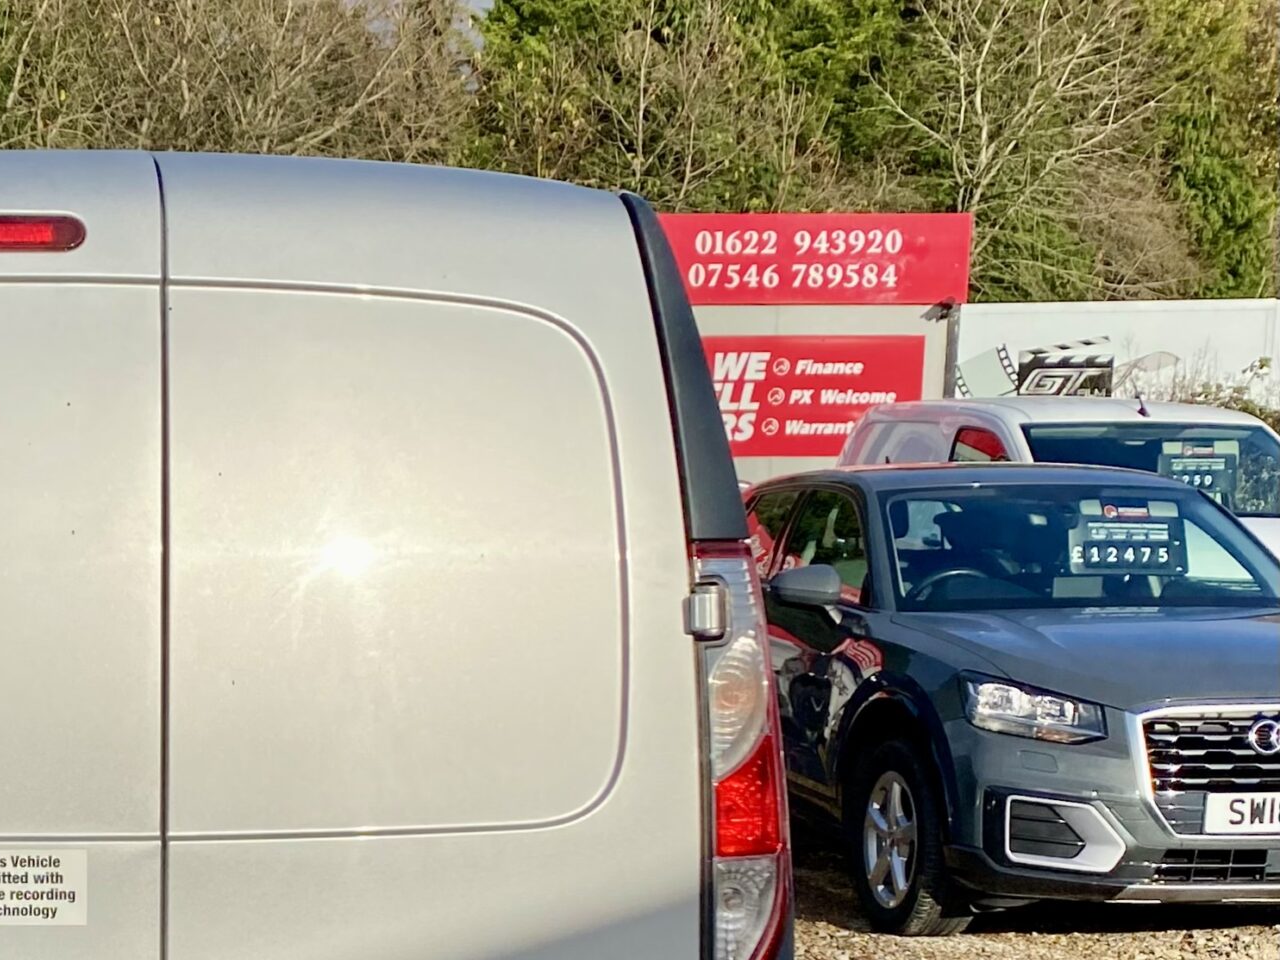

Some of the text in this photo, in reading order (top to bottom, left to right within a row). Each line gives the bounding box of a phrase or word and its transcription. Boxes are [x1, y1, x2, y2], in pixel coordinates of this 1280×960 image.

[694, 229, 903, 255] 01622 943920
[688, 262, 898, 288] 07546 789584
[713, 352, 771, 380] WE
[794, 358, 864, 375] Finance
[789, 388, 896, 405] PX Welcome
[1071, 546, 1169, 563] £12475
[11, 855, 61, 868] Vehicle
[33, 872, 64, 884] with
[10, 888, 76, 903] recording
